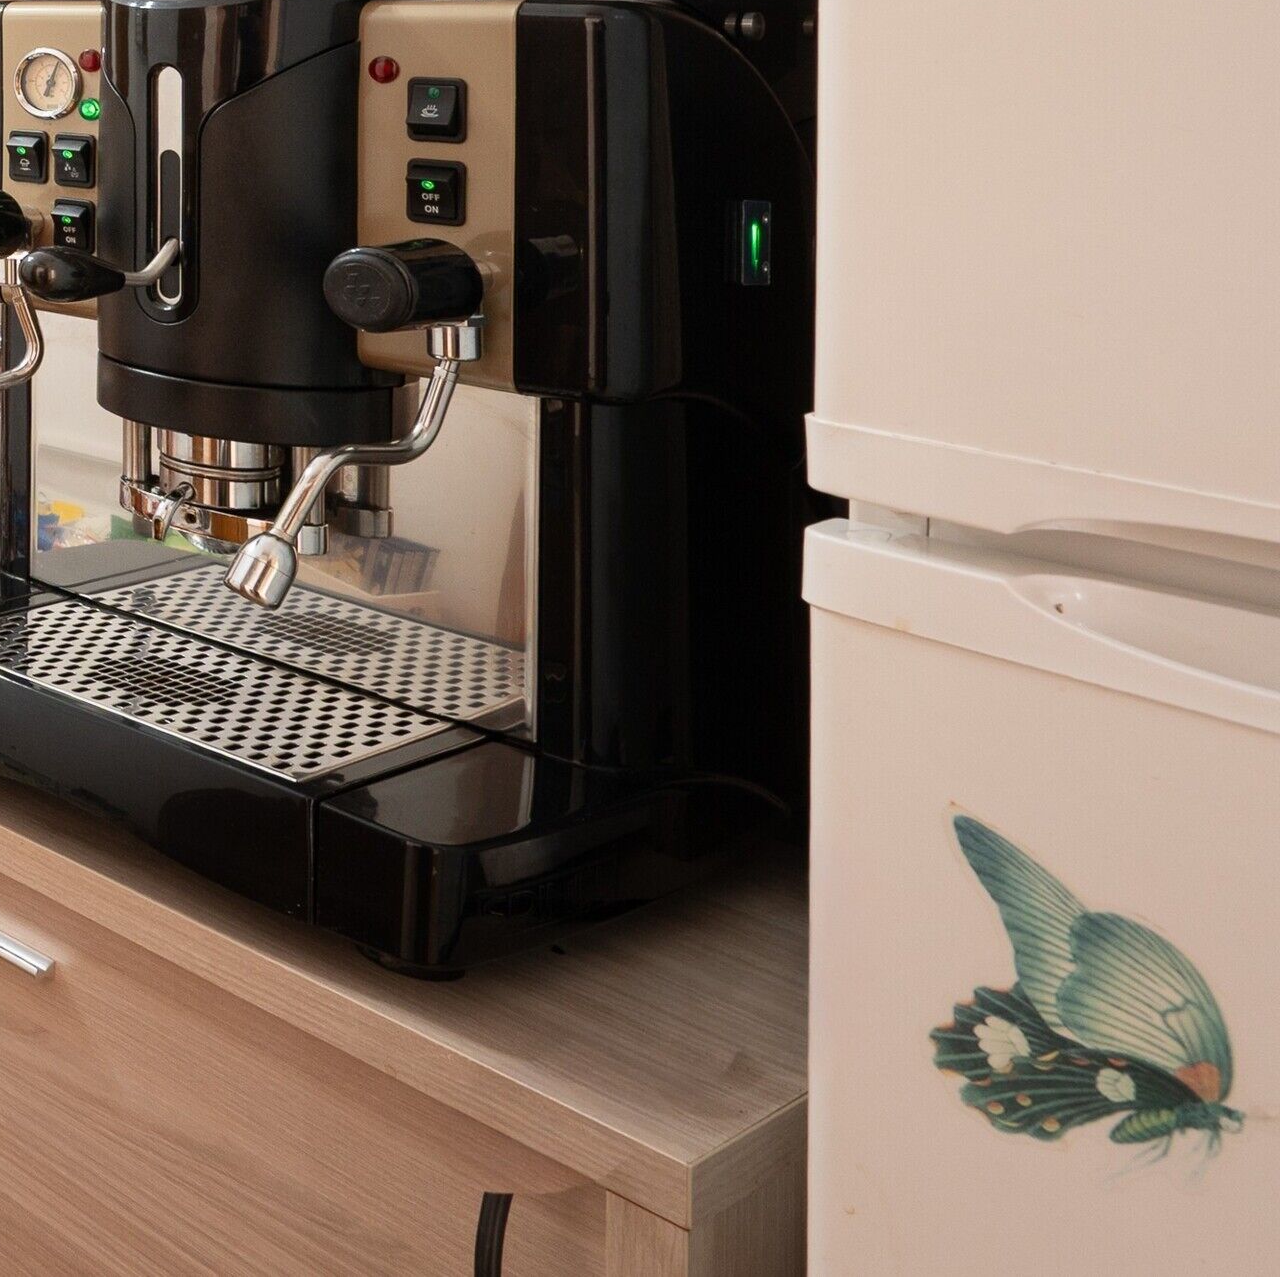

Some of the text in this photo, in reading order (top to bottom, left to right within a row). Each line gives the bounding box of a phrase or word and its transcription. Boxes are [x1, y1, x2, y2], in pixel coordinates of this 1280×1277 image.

[421, 193, 440, 201] OFF
[424, 204, 439, 213] ON
[65, 236, 77, 244] ON
